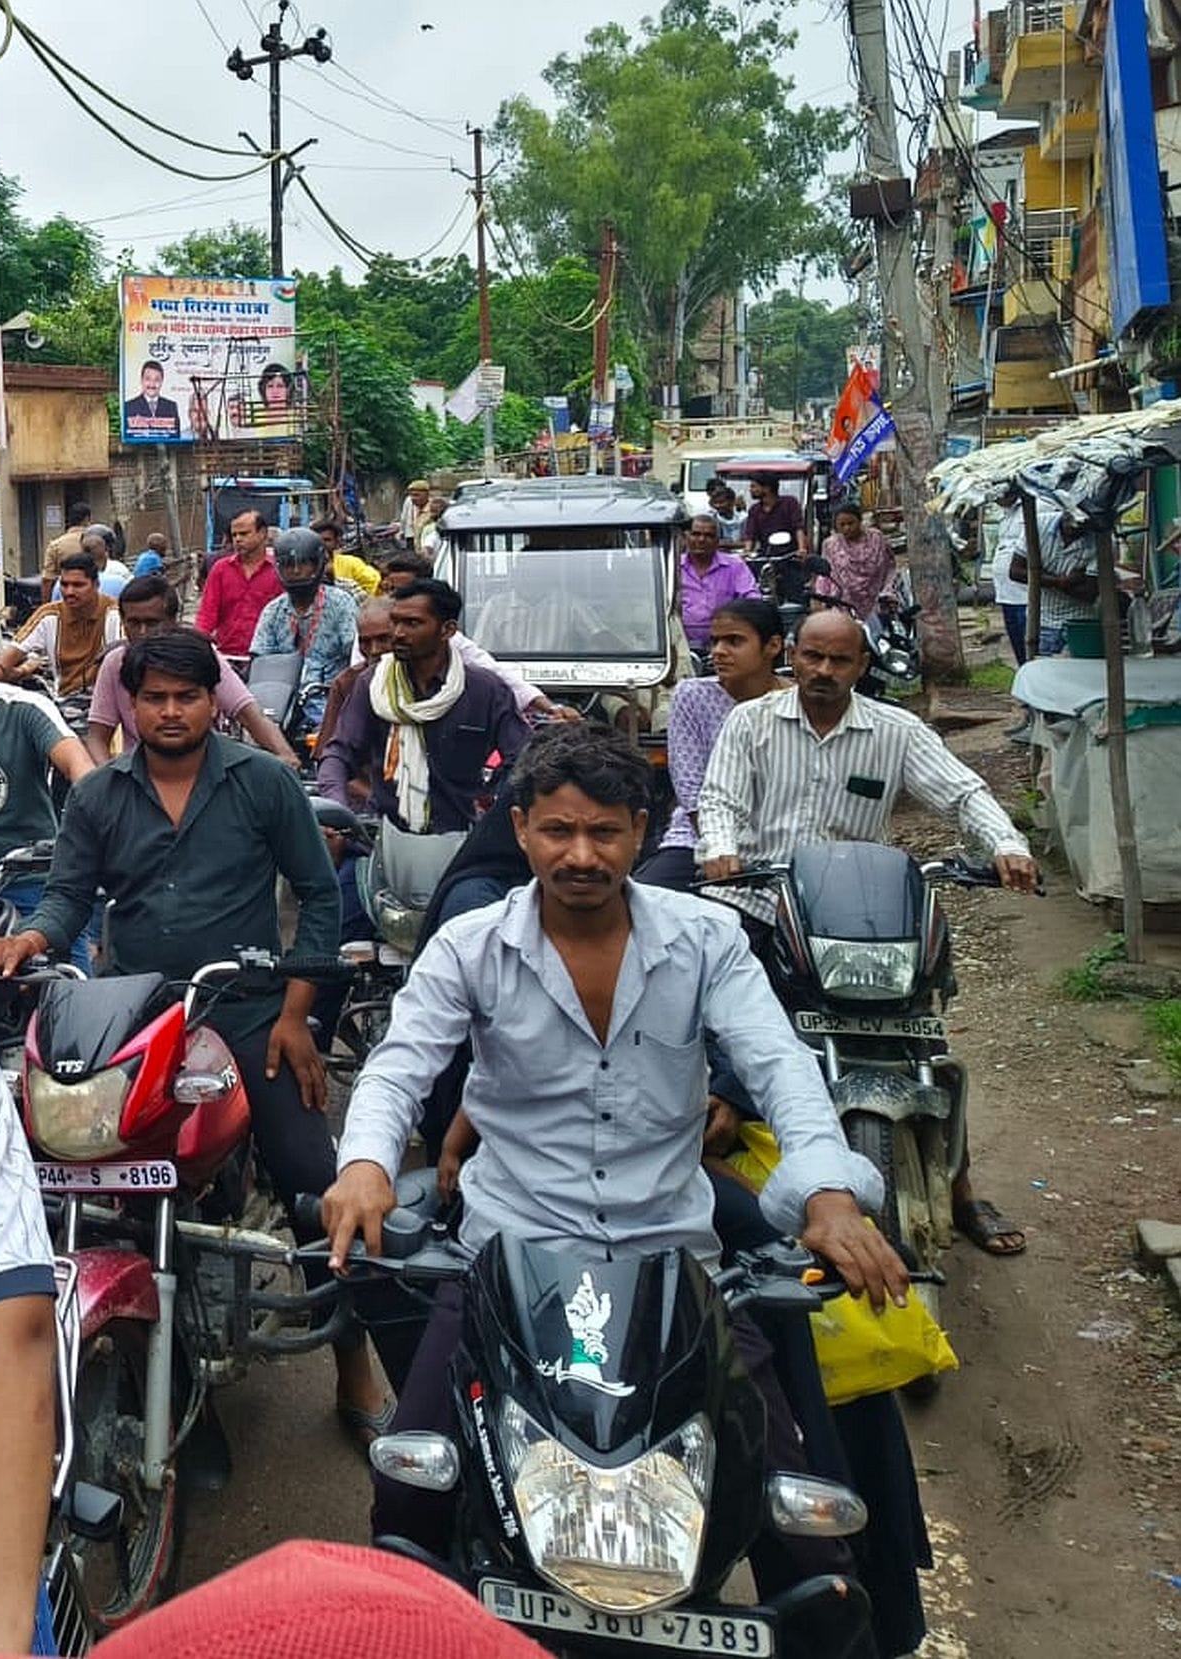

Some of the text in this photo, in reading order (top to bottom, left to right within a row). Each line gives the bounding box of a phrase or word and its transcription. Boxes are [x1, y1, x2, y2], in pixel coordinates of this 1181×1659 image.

[56, 1060, 85, 1073] TVS
[90, 1167, 101, 1185] S
[129, 1165, 172, 1185] 8196
[520, 1593, 556, 1623] UP
[676, 1617, 760, 1654] 7989
